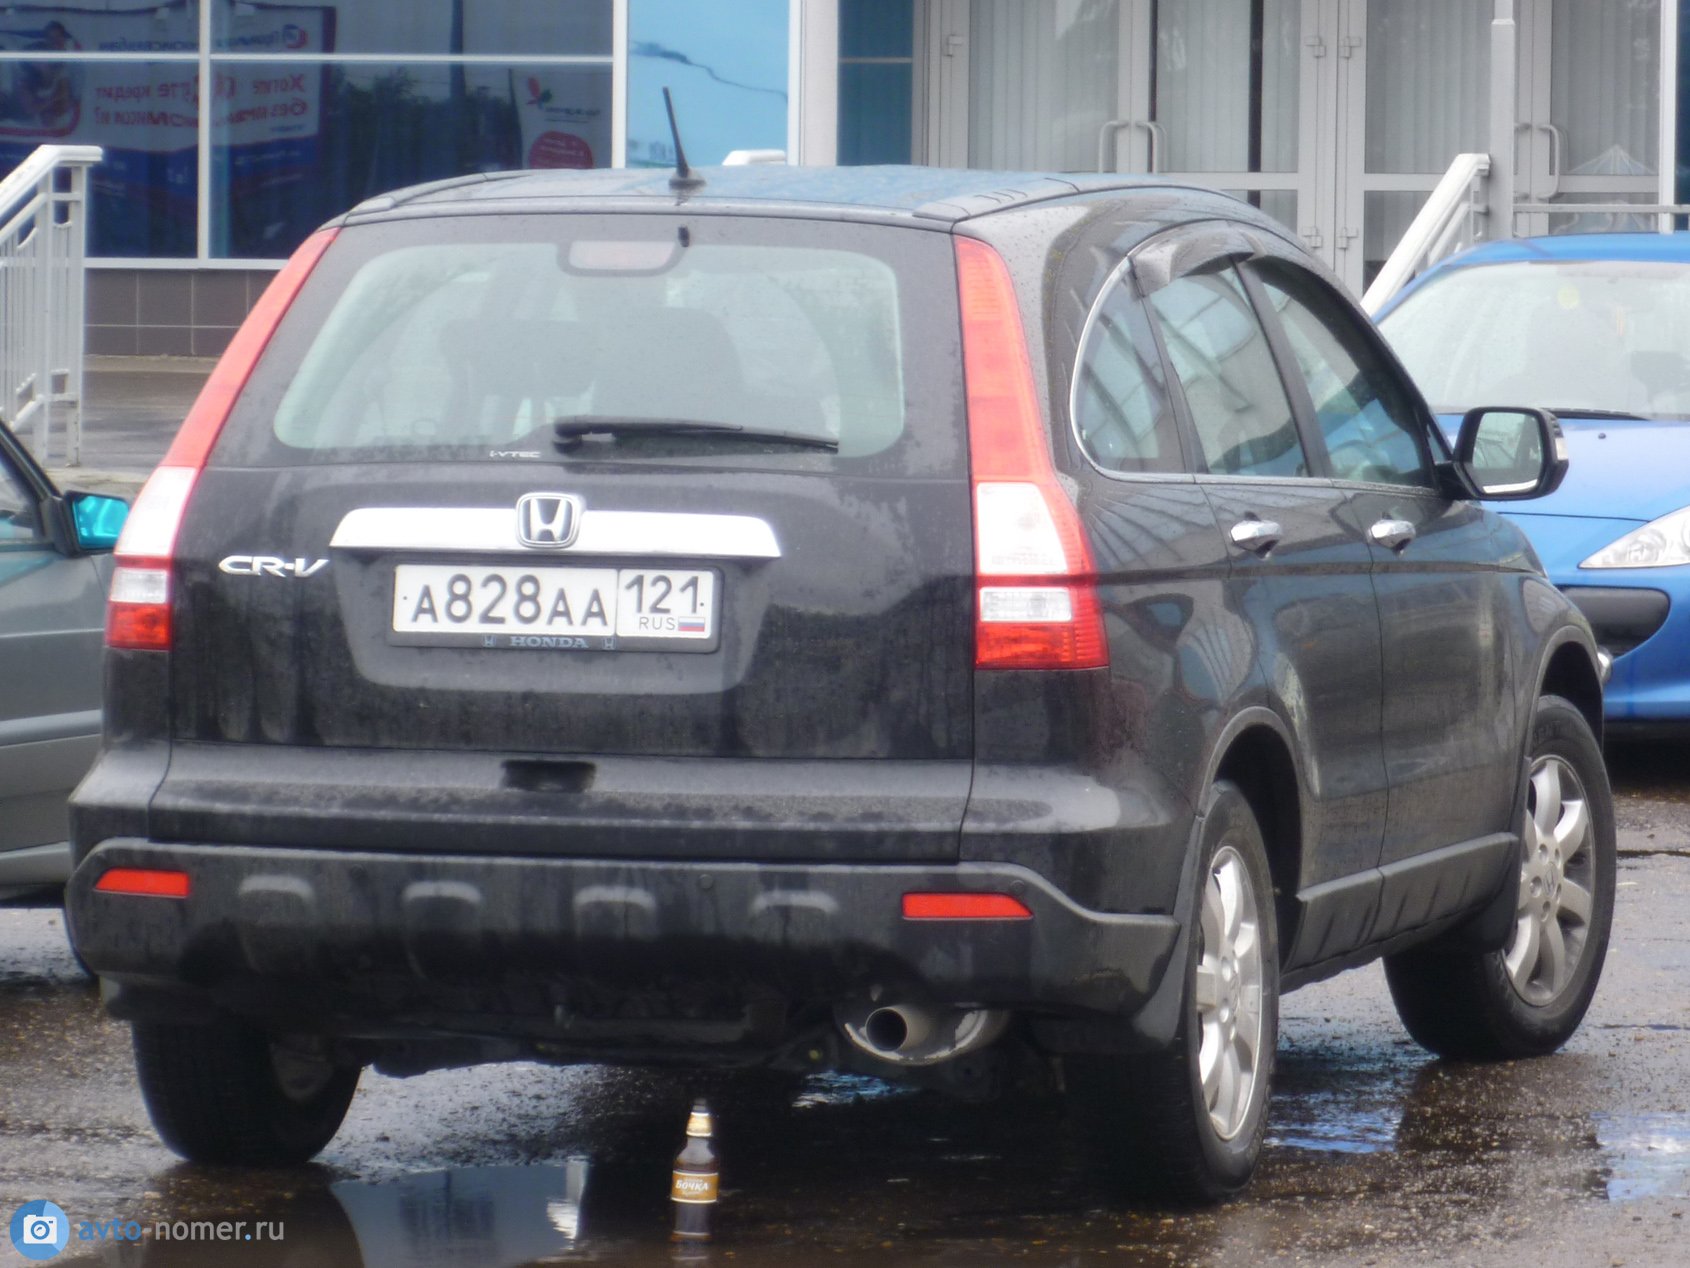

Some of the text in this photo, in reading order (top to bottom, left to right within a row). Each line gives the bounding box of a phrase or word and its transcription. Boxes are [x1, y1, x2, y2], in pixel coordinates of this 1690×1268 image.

[218, 555, 329, 577] CR-V
[624, 574, 700, 614] 121
[638, 616, 676, 631] RUS
[509, 636, 590, 649] HONDA
